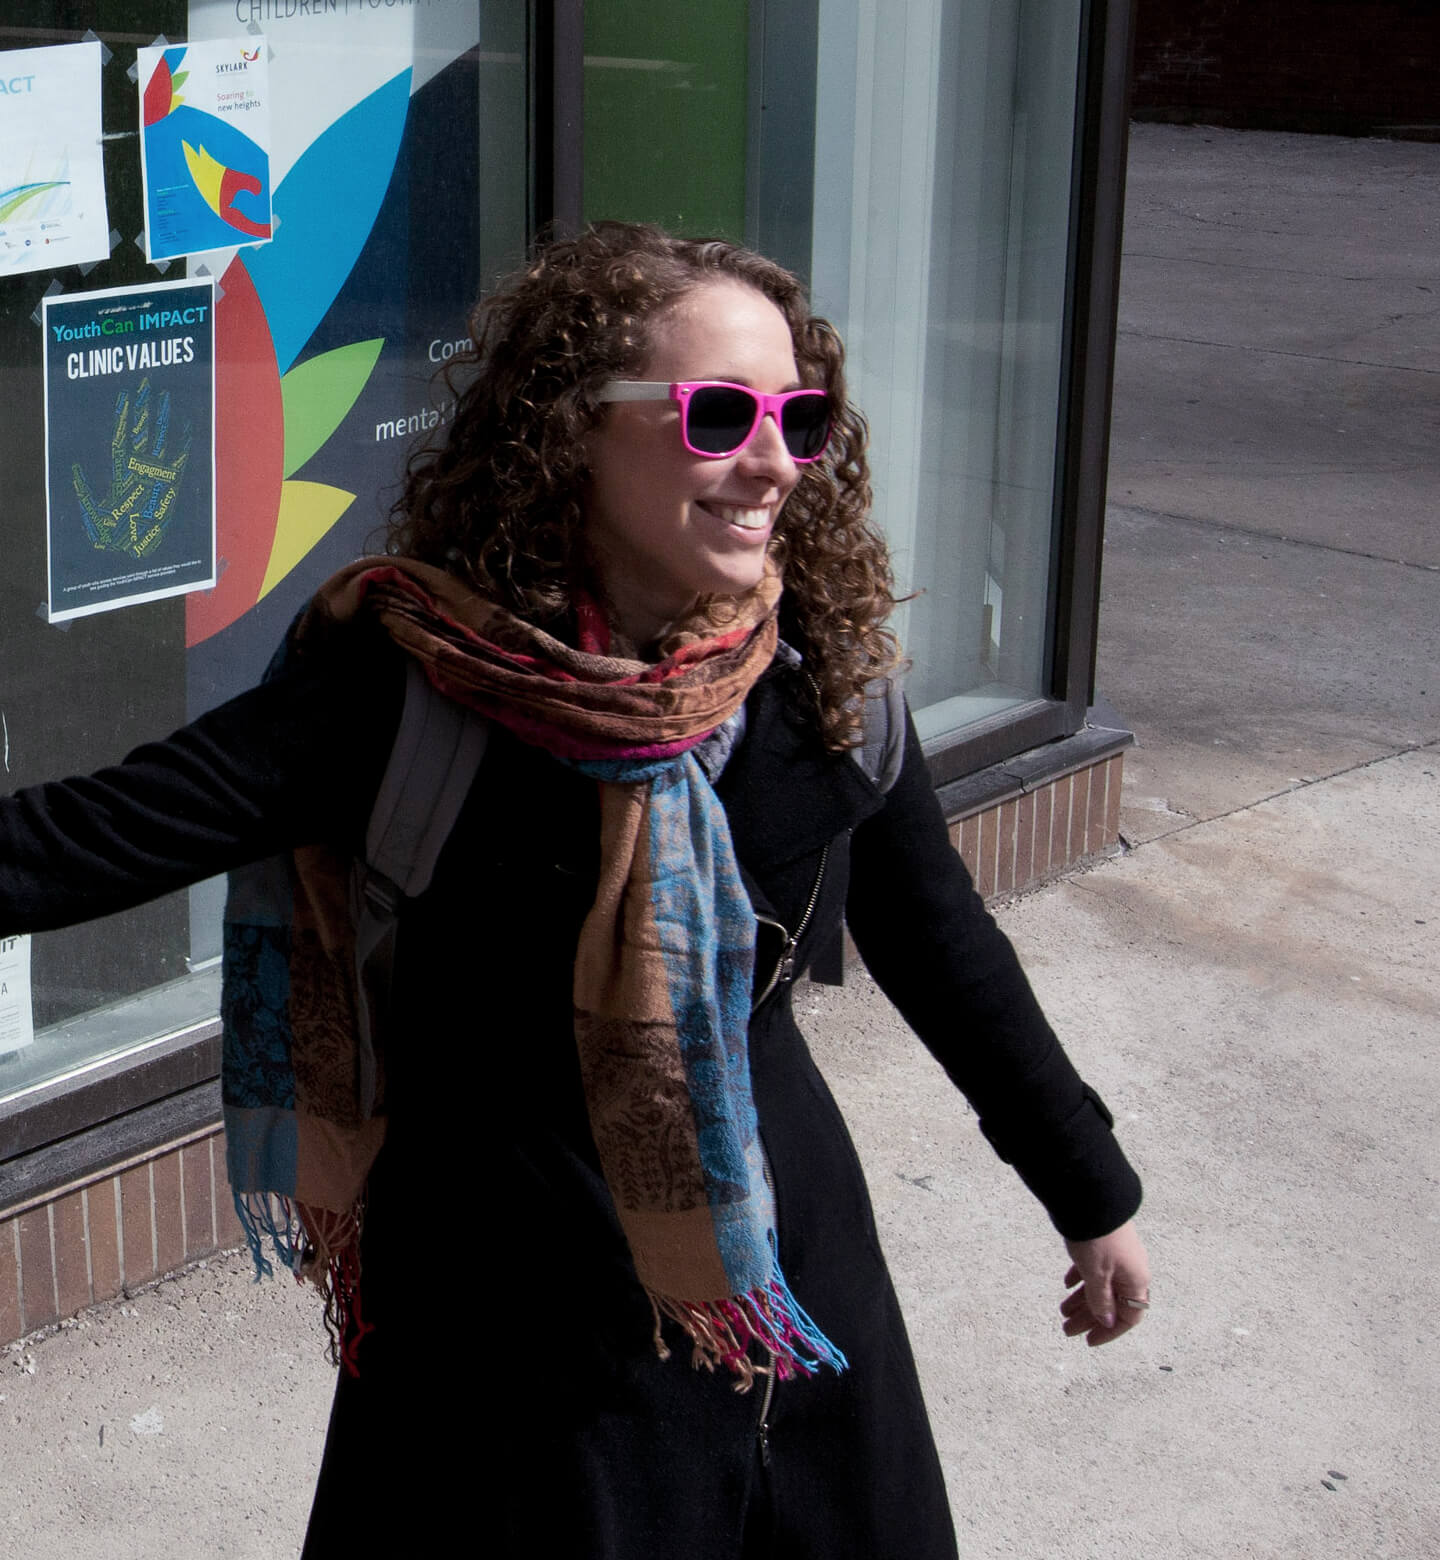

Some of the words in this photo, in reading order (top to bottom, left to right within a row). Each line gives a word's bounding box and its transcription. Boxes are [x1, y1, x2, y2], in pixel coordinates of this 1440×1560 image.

[216, 62, 247, 73] SKYLARK
[218, 104, 233, 112] new
[234, 100, 261, 111] heights
[52, 318, 134, 342] YouthCan
[139, 306, 208, 331] IMPACT
[67, 346, 123, 380] CLINIC
[125, 336, 194, 371] VALUES
[428, 338, 473, 362] Com
[375, 401, 446, 442] mental
[127, 457, 177, 481] Engagment
[112, 484, 145, 521] Respect
[154, 487, 176, 520] Safety
[129, 512, 140, 542] Love
[133, 524, 161, 558] Justice
